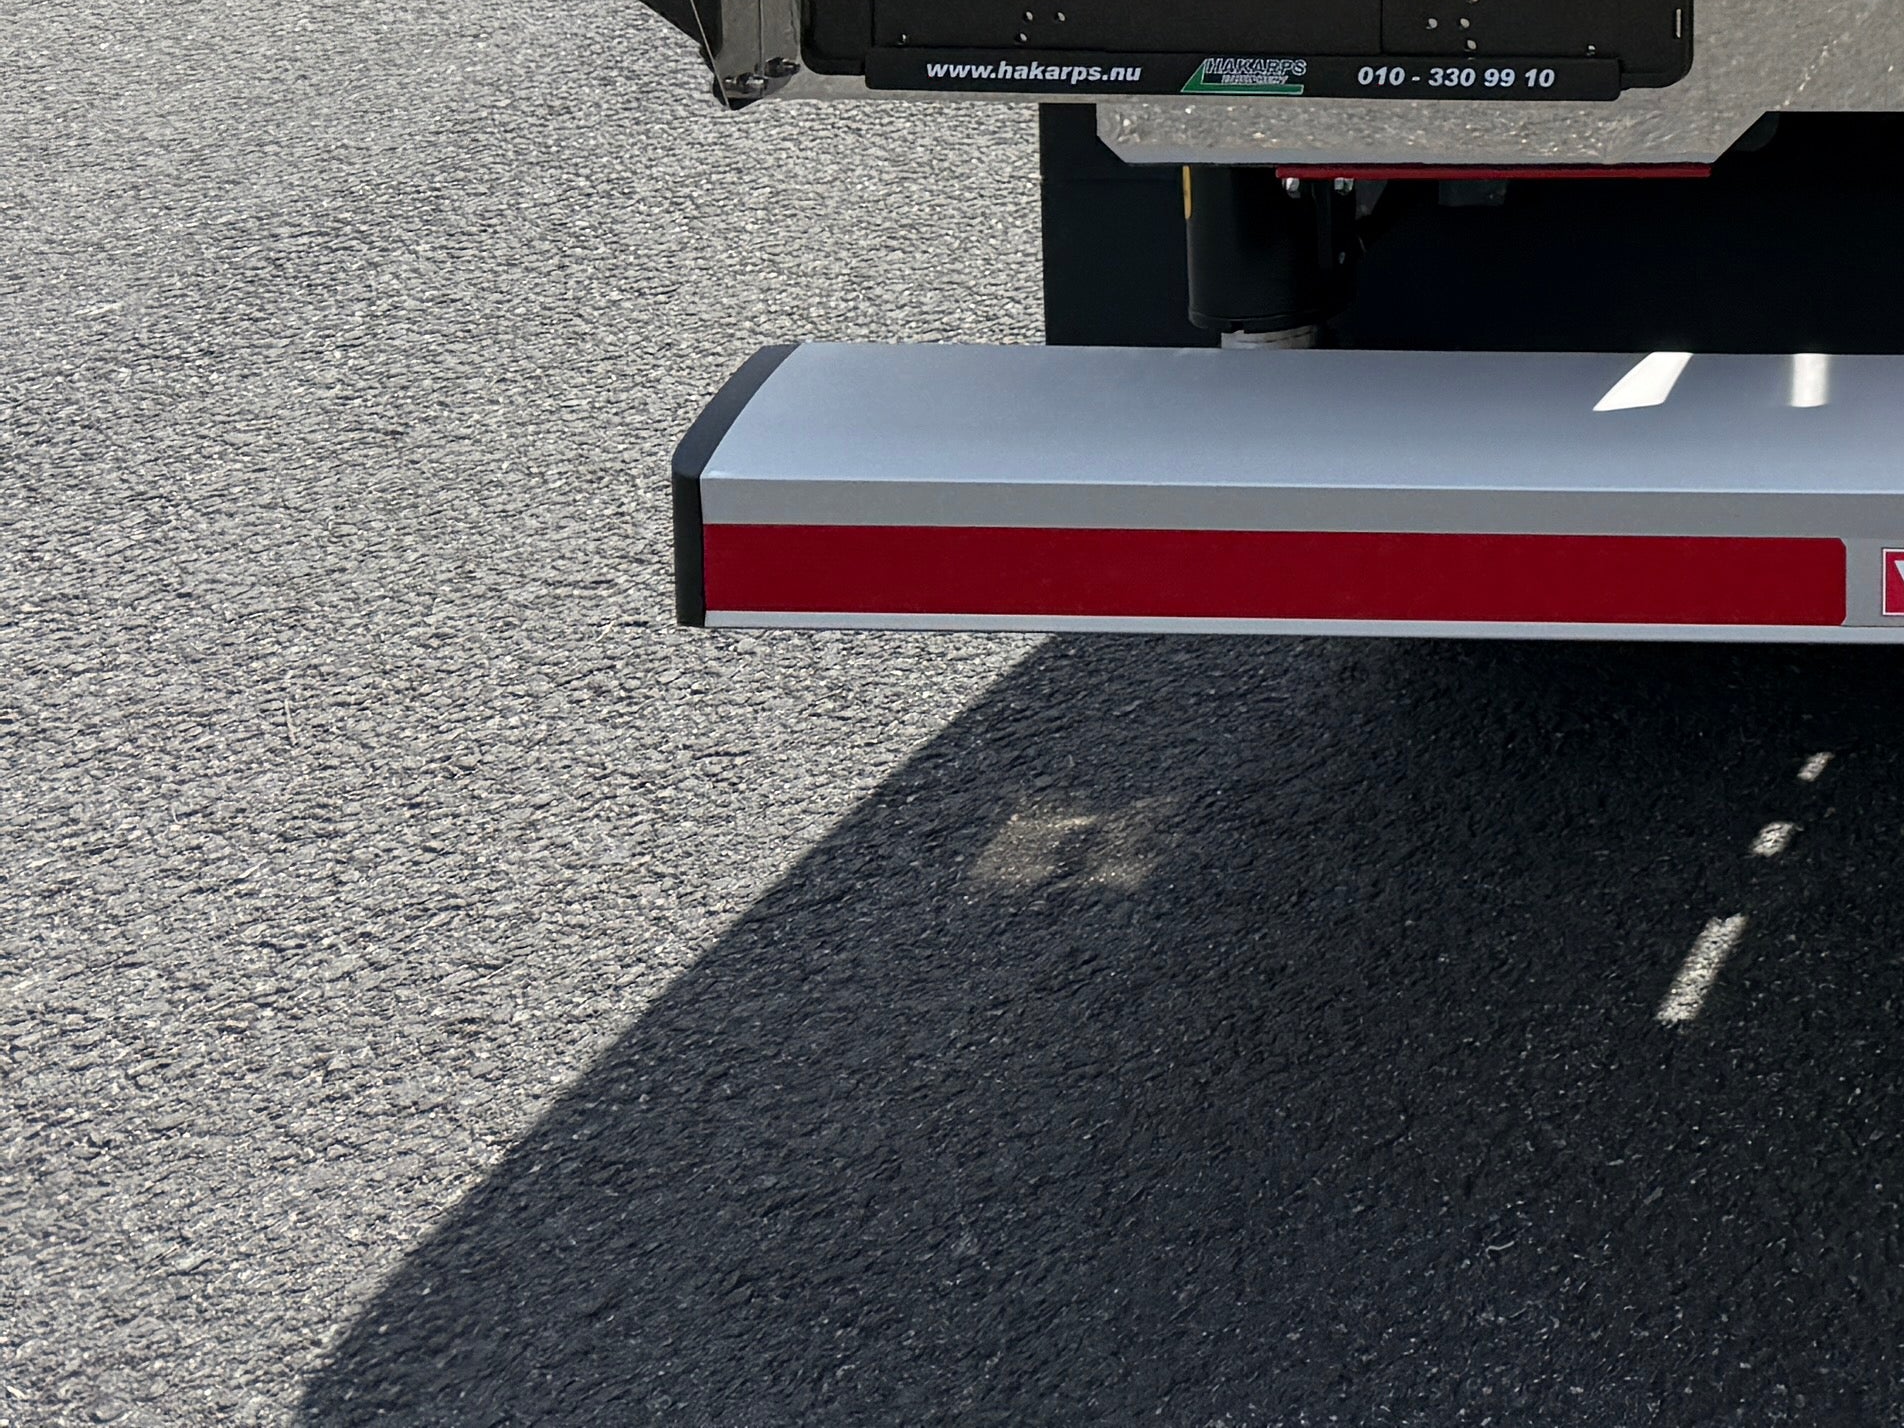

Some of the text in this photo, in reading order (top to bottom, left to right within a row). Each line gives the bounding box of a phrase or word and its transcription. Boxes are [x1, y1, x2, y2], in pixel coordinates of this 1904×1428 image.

[926, 60, 1142, 85] www.hakarps.nu
[1205, 57, 1307, 76] HAKARPS
[1357, 66, 1406, 86] 010
[1427, 67, 1476, 87] 330
[1483, 68, 1516, 87] 99
[1524, 68, 1555, 88] 10
